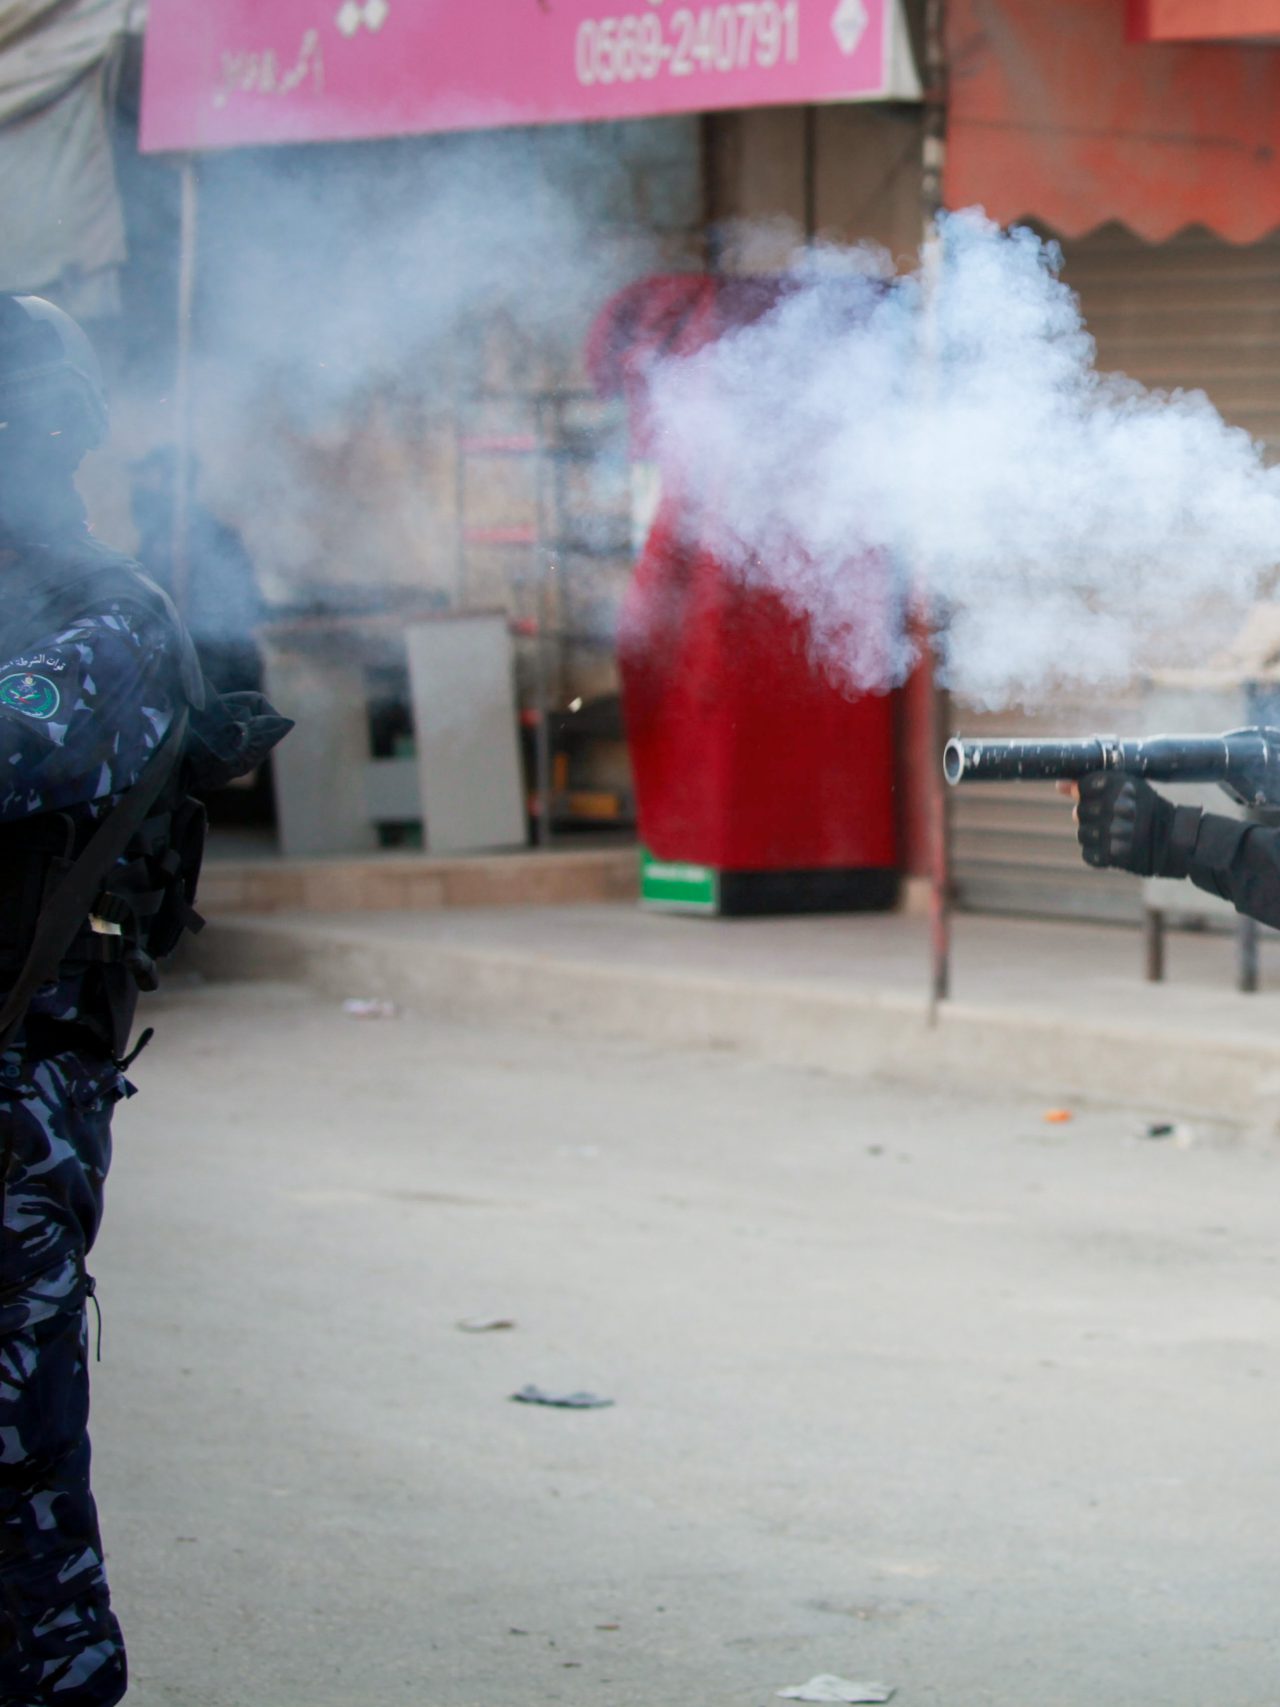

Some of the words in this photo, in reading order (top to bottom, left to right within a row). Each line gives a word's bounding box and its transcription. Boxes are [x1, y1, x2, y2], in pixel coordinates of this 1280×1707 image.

[575, 1, 798, 86] 0569-240791
[15, 654, 45, 668] الشرطة
[46, 658, 66, 671] قوات
